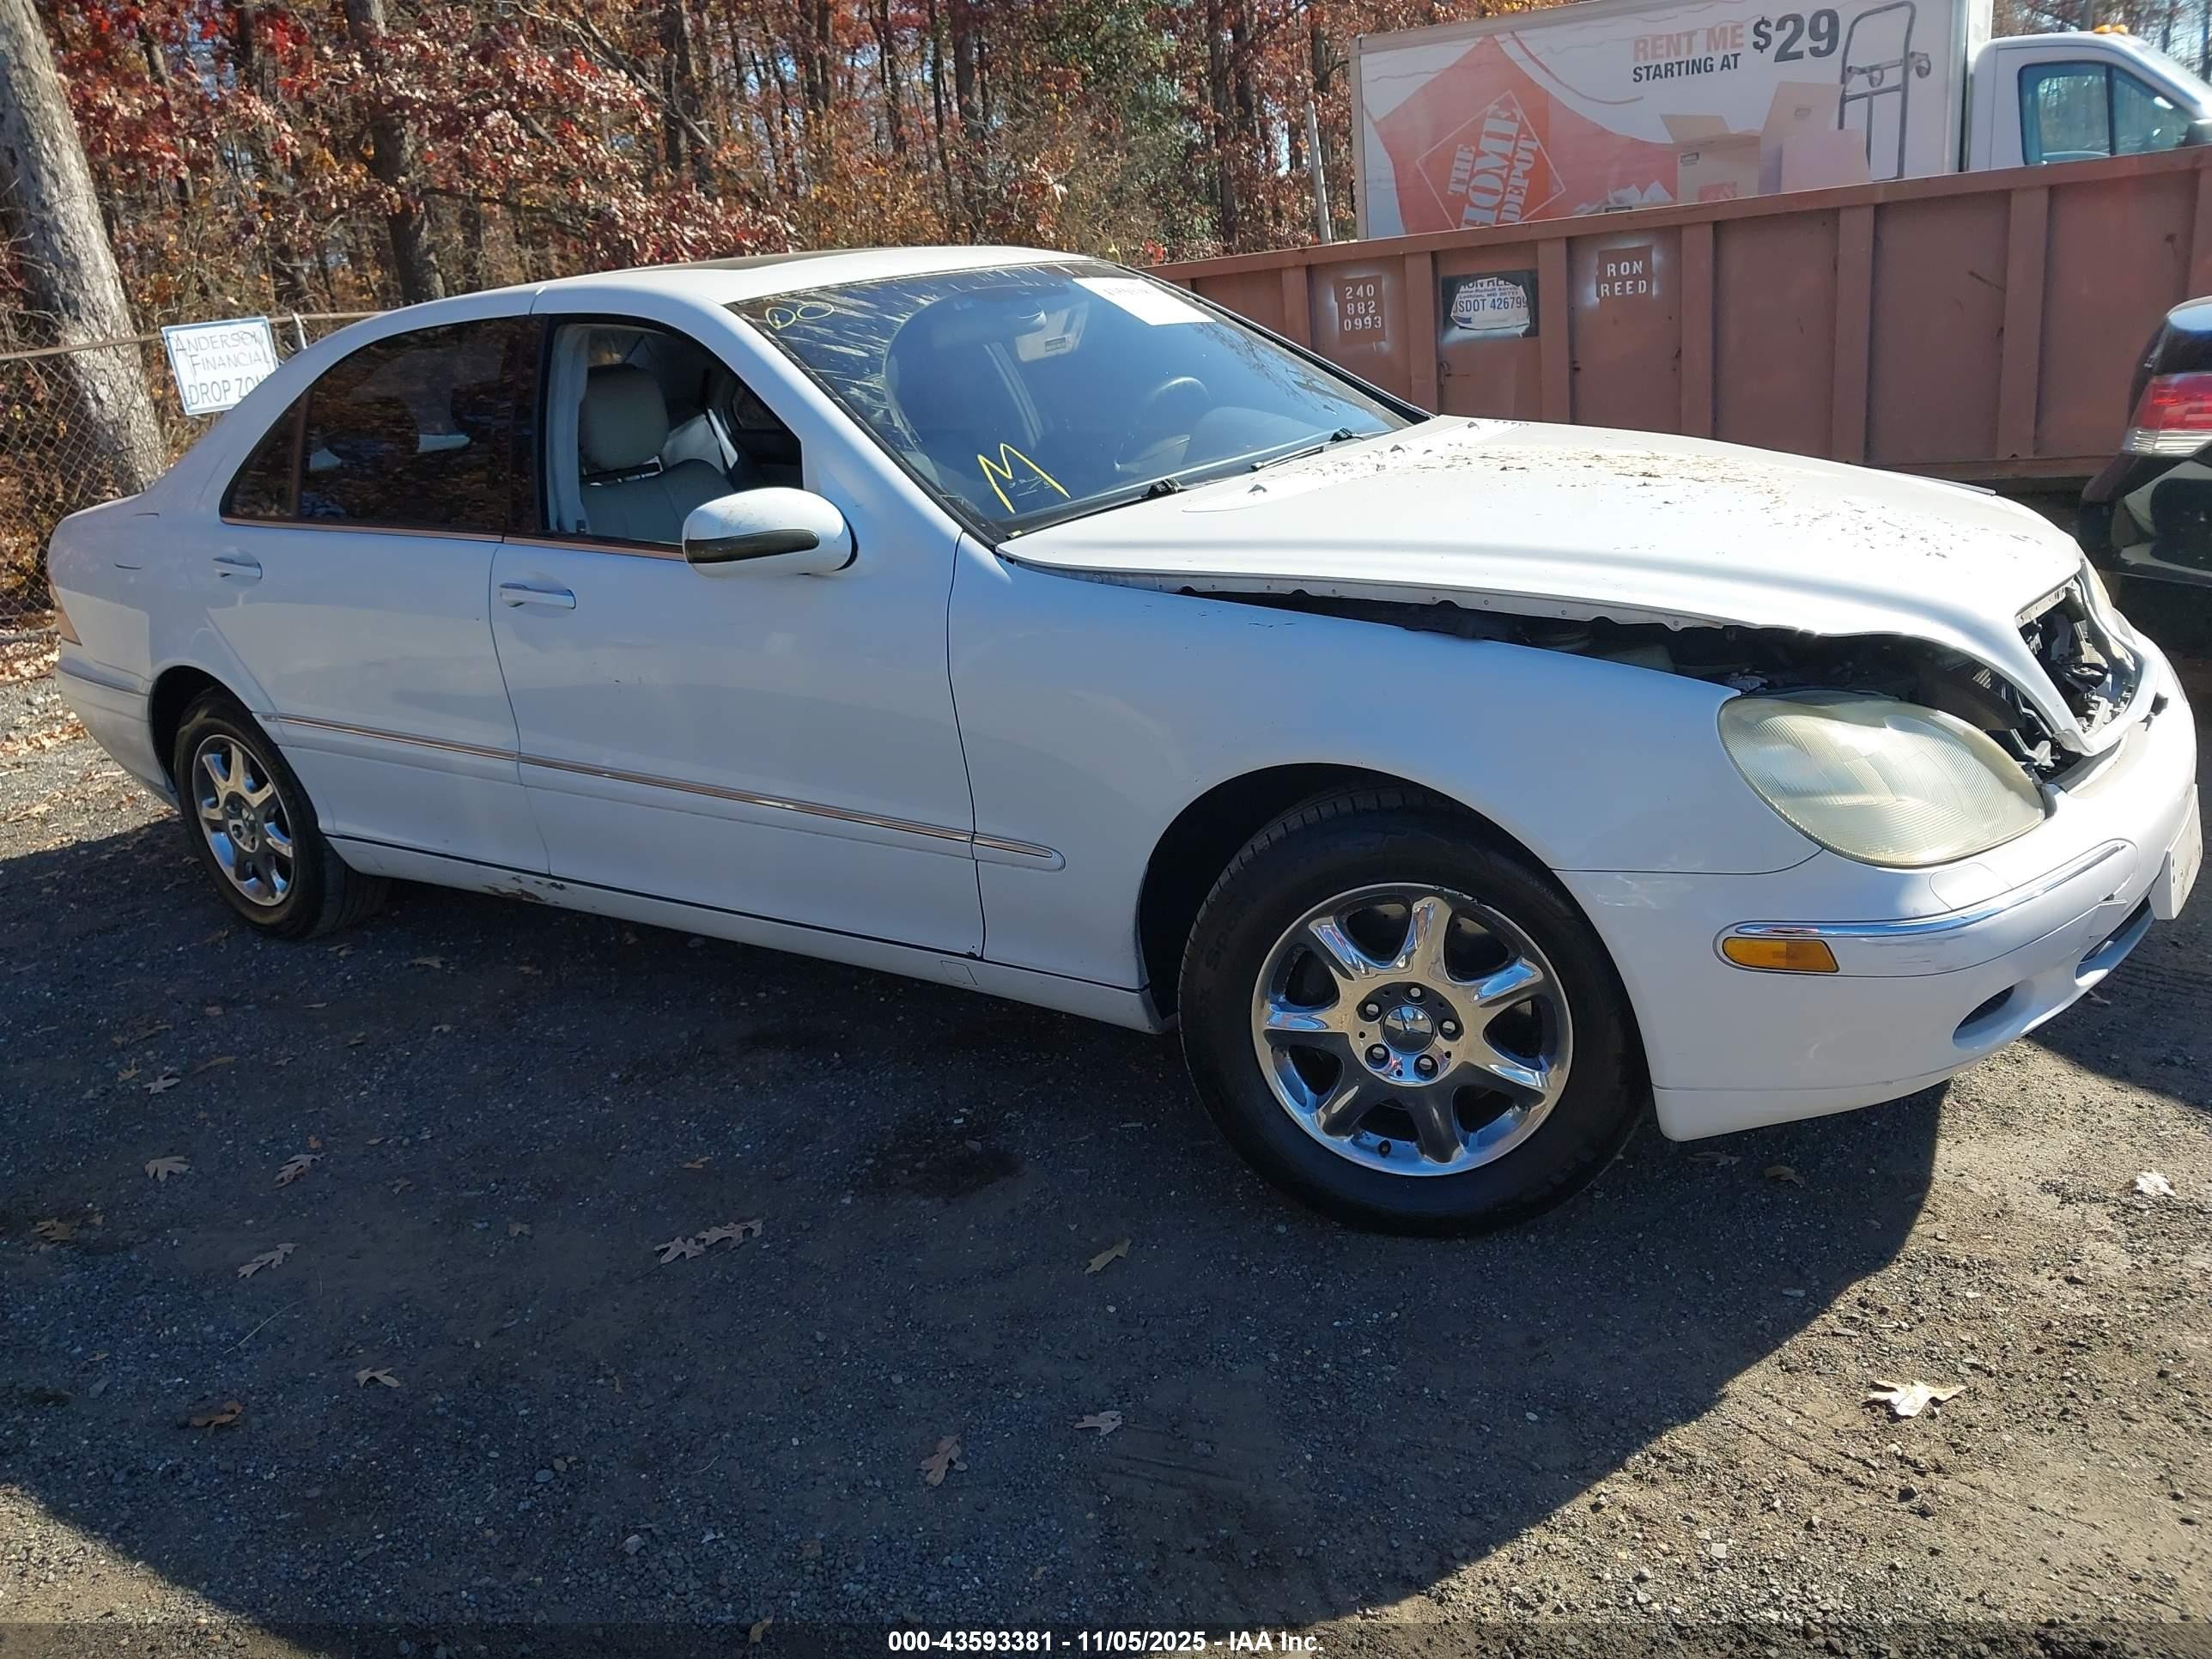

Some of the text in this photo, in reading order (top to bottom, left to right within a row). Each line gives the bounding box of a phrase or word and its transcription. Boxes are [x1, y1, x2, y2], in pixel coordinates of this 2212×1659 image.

[1633, 24, 1745, 64] RENT ME
[1752, 8, 1840, 63] $29
[1632, 52, 1741, 83] STARTING AT
[1448, 143, 1475, 195] THE
[1499, 134, 1539, 222] DEPOT
[1607, 260, 1643, 277] RON
[1345, 284, 1375, 300] 240
[1601, 280, 1647, 298] REED
[1346, 301, 1376, 316] 882
[1344, 315, 1382, 331] 0993
[173, 329, 264, 354] ANDERSON
[188, 344, 270, 373] FINANCIAL
[187, 379, 231, 406] DROP
[976, 442, 1072, 514] M
